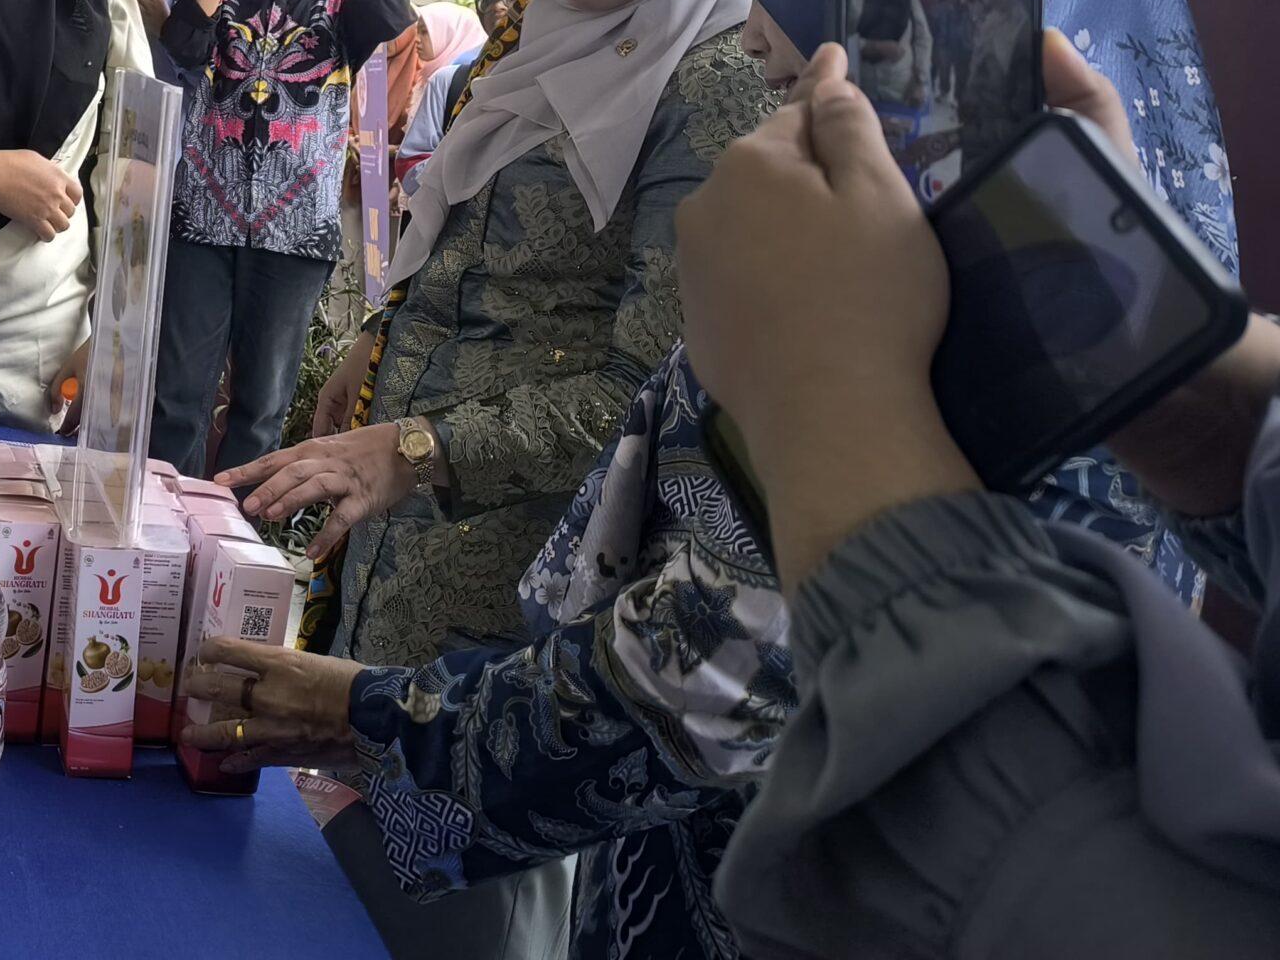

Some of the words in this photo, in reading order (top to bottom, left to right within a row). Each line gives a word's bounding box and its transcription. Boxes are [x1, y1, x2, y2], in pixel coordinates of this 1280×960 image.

[0, 580, 48, 589] SHANGRATU
[82, 610, 135, 619] SHANGRATU
[295, 775, 338, 793] GRATU
